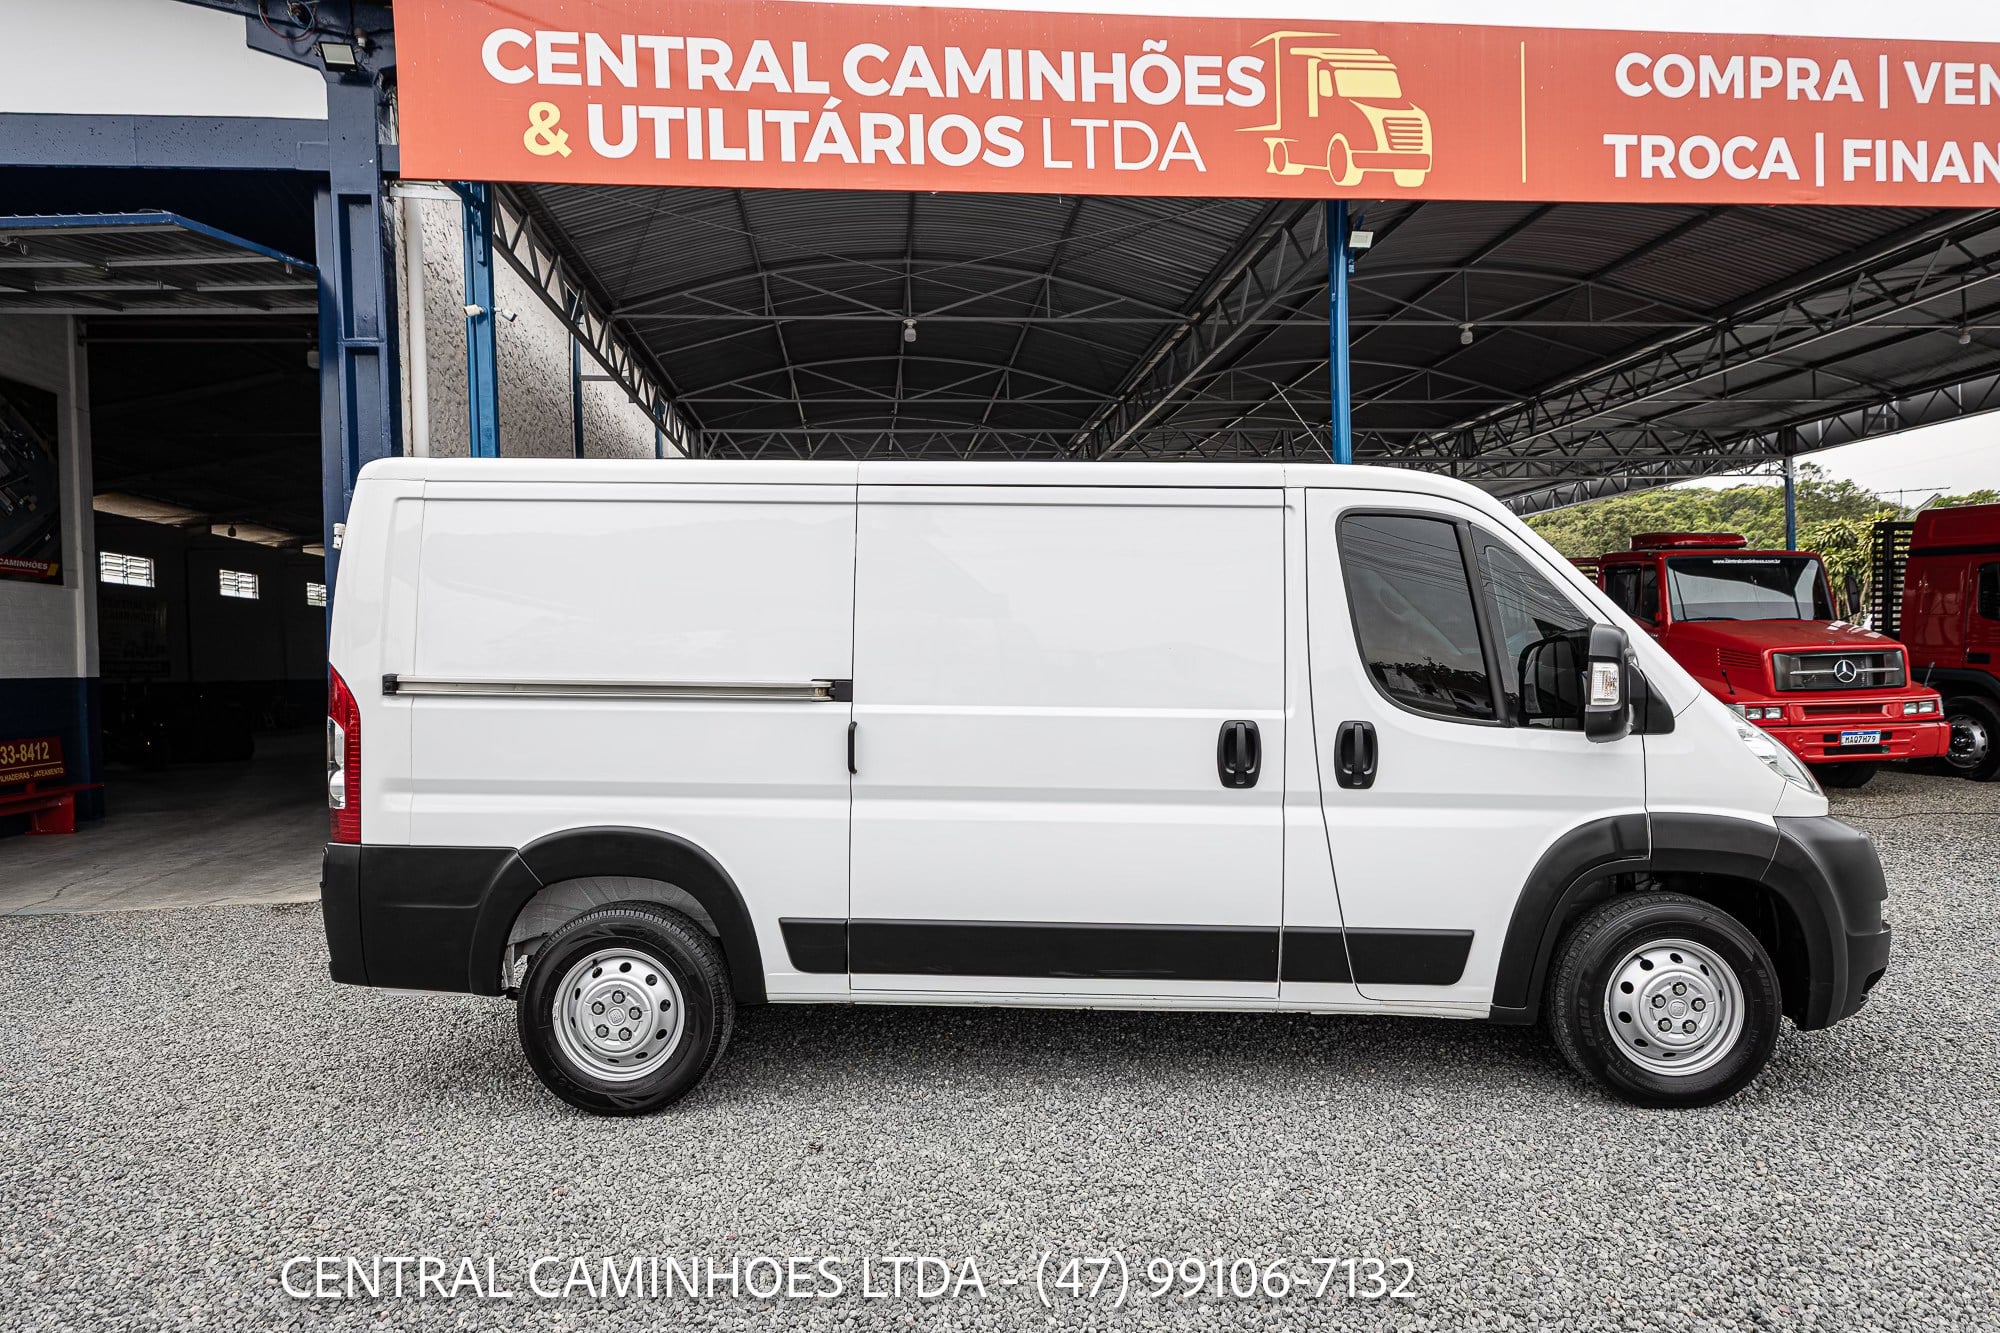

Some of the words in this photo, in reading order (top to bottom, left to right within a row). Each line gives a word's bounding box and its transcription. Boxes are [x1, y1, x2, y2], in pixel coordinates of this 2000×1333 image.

[481, 28, 830, 95] CENTRAL
[841, 39, 1266, 108] CAMINHÕES
[1615, 52, 1864, 102] COMPRA
[1903, 61, 2000, 106] VEN
[523, 101, 572, 158] &
[587, 97, 1025, 168] UTILITÁRIOS
[1042, 118, 1207, 172] LTDA
[1603, 133, 1800, 181] TROCA
[1843, 138, 2000, 184] FINAN
